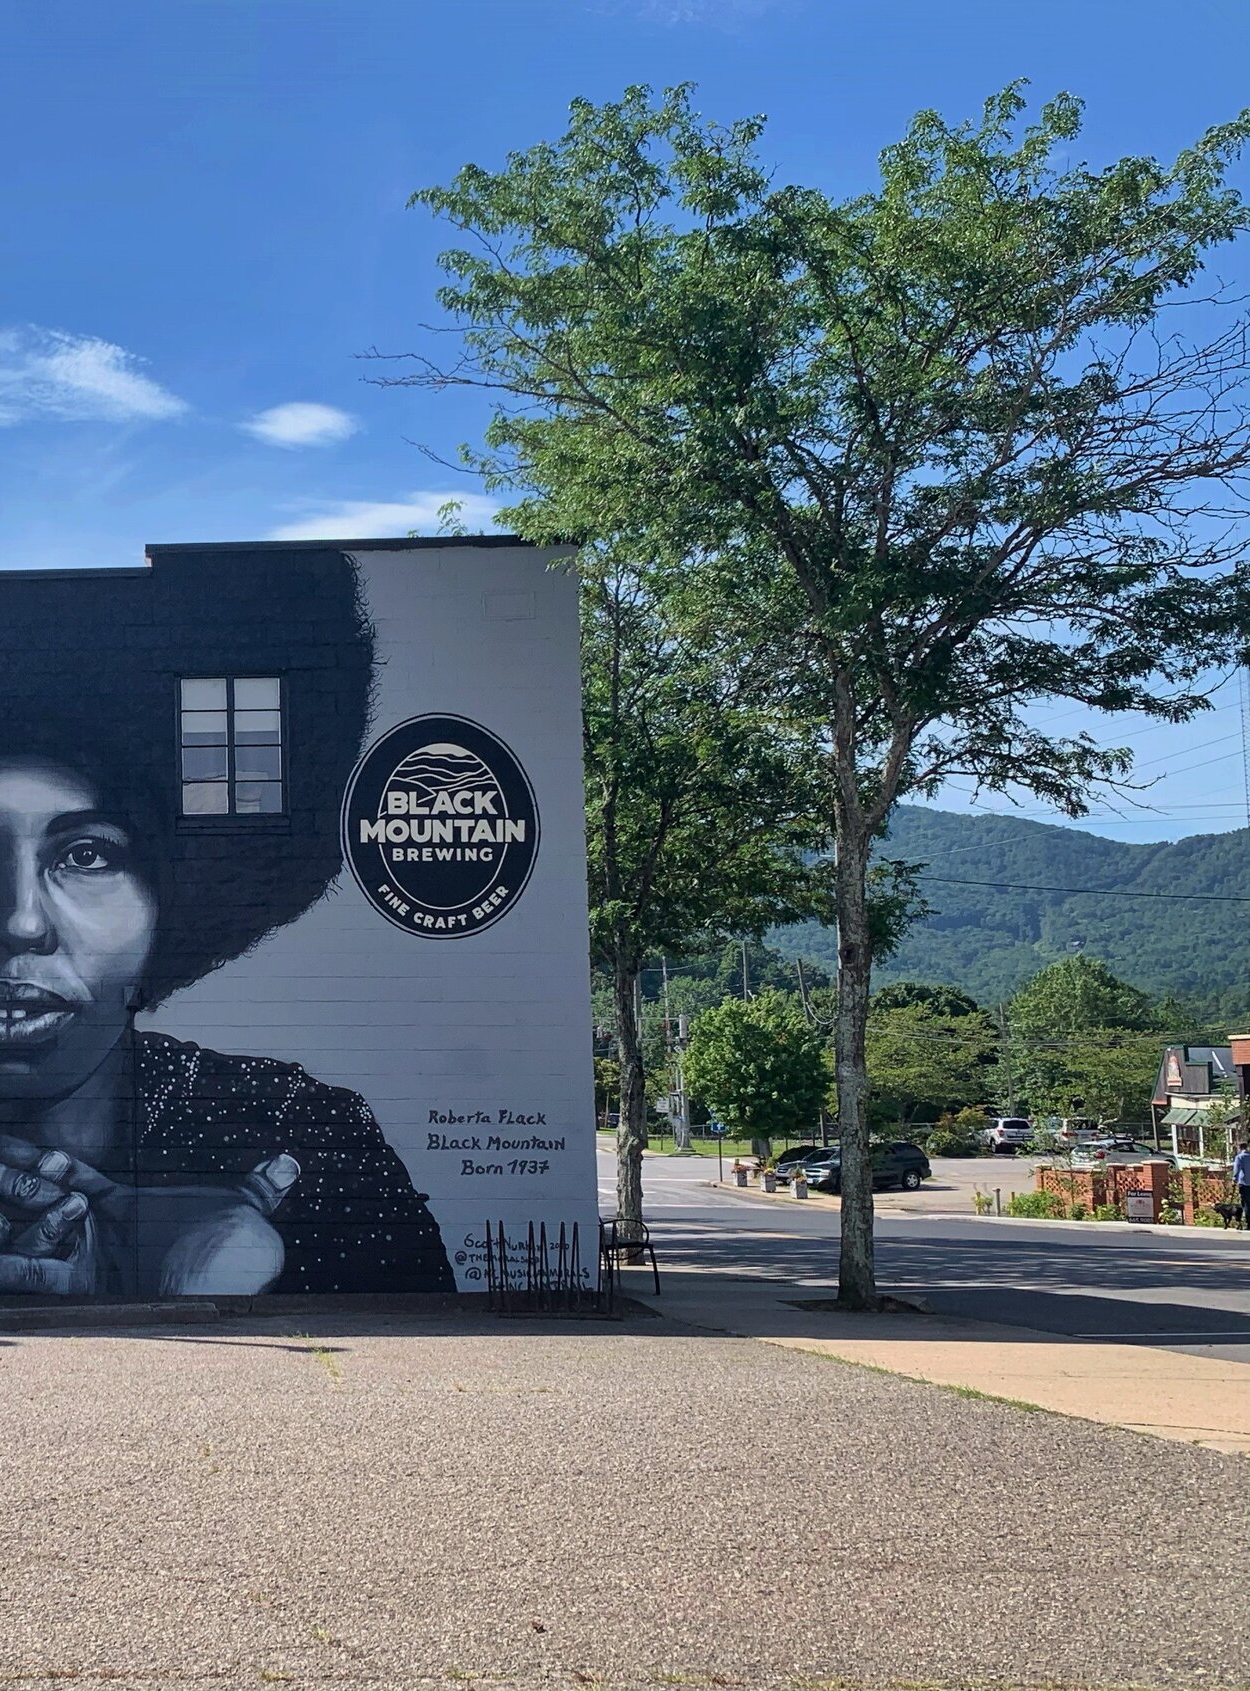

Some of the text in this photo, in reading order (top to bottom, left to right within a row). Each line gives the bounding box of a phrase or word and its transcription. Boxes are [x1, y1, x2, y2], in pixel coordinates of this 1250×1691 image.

[387, 790, 498, 815] BLACK
[360, 819, 525, 843] MOUNTAIN
[392, 848, 493, 861] BREWING
[378, 884, 509, 928] FINE CRAFT BEER
[428, 1109, 491, 1124] Roberta
[461, 1159, 550, 1175] Born 1937
[550, 1242, 570, 1251] 200
